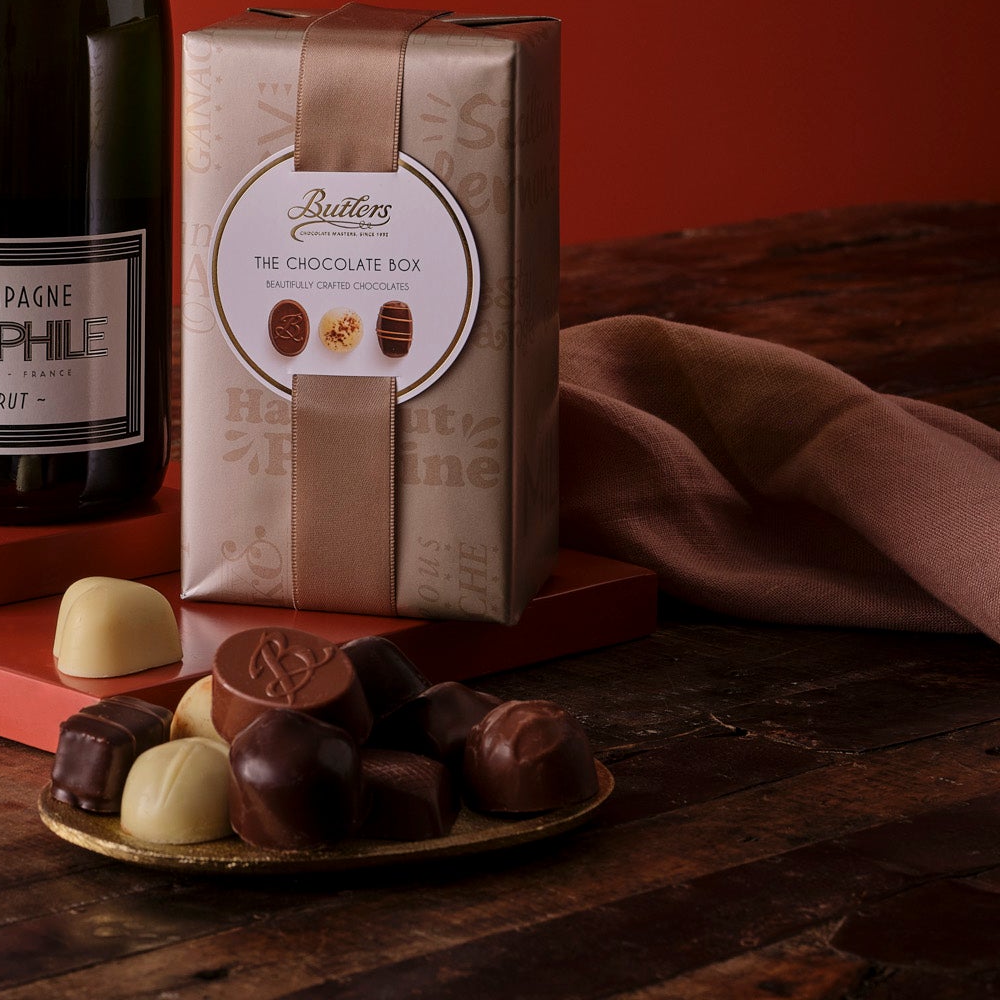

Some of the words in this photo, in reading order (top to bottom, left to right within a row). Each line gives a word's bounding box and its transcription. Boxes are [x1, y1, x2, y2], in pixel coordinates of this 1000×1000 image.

[287, 187, 392, 230] Butlers
[254, 256, 279, 270] THE
[286, 256, 382, 271] CHOCOLATE
[388, 258, 421, 272] BOX
[266, 280, 314, 290] BEAUTIFULLY
[316, 281, 351, 290] CRAFTED
[353, 281, 410, 291] CHOCOLATES
[23, 368, 73, 379] FRANCE
